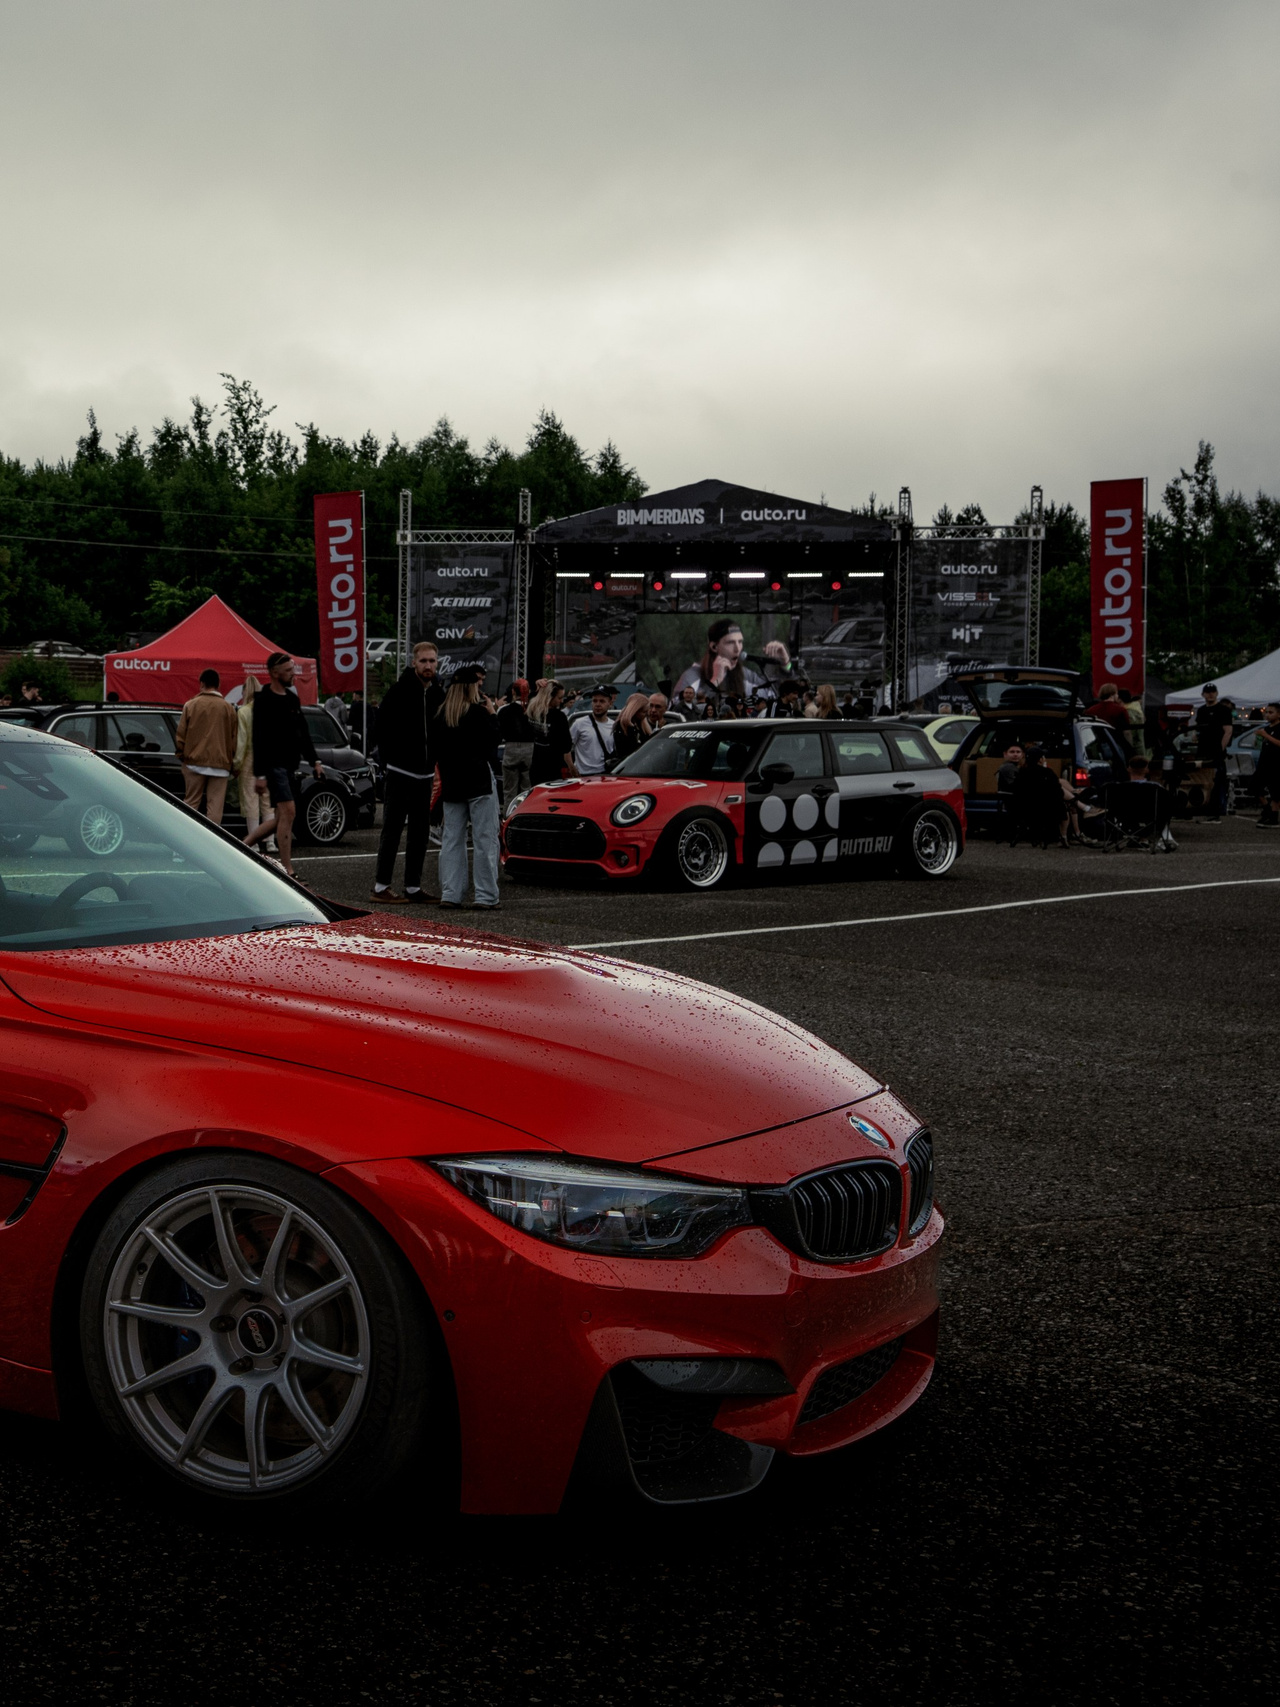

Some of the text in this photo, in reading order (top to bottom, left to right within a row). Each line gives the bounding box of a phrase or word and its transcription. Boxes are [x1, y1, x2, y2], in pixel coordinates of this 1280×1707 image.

[617, 508, 705, 525] BIMMERDAYS
[740, 508, 806, 521] auto.ru
[437, 566, 488, 577] auto.ru
[941, 563, 998, 575] auto.ru
[611, 583, 638, 592] auto.ru
[1099, 508, 1133, 676] auto.ru
[328, 518, 359, 673] auto.ru
[431, 597, 492, 608] XENUM
[435, 628, 466, 639] GNV
[113, 658, 171, 671] auto.ru
[840, 835, 894, 857] AUTO.RU
